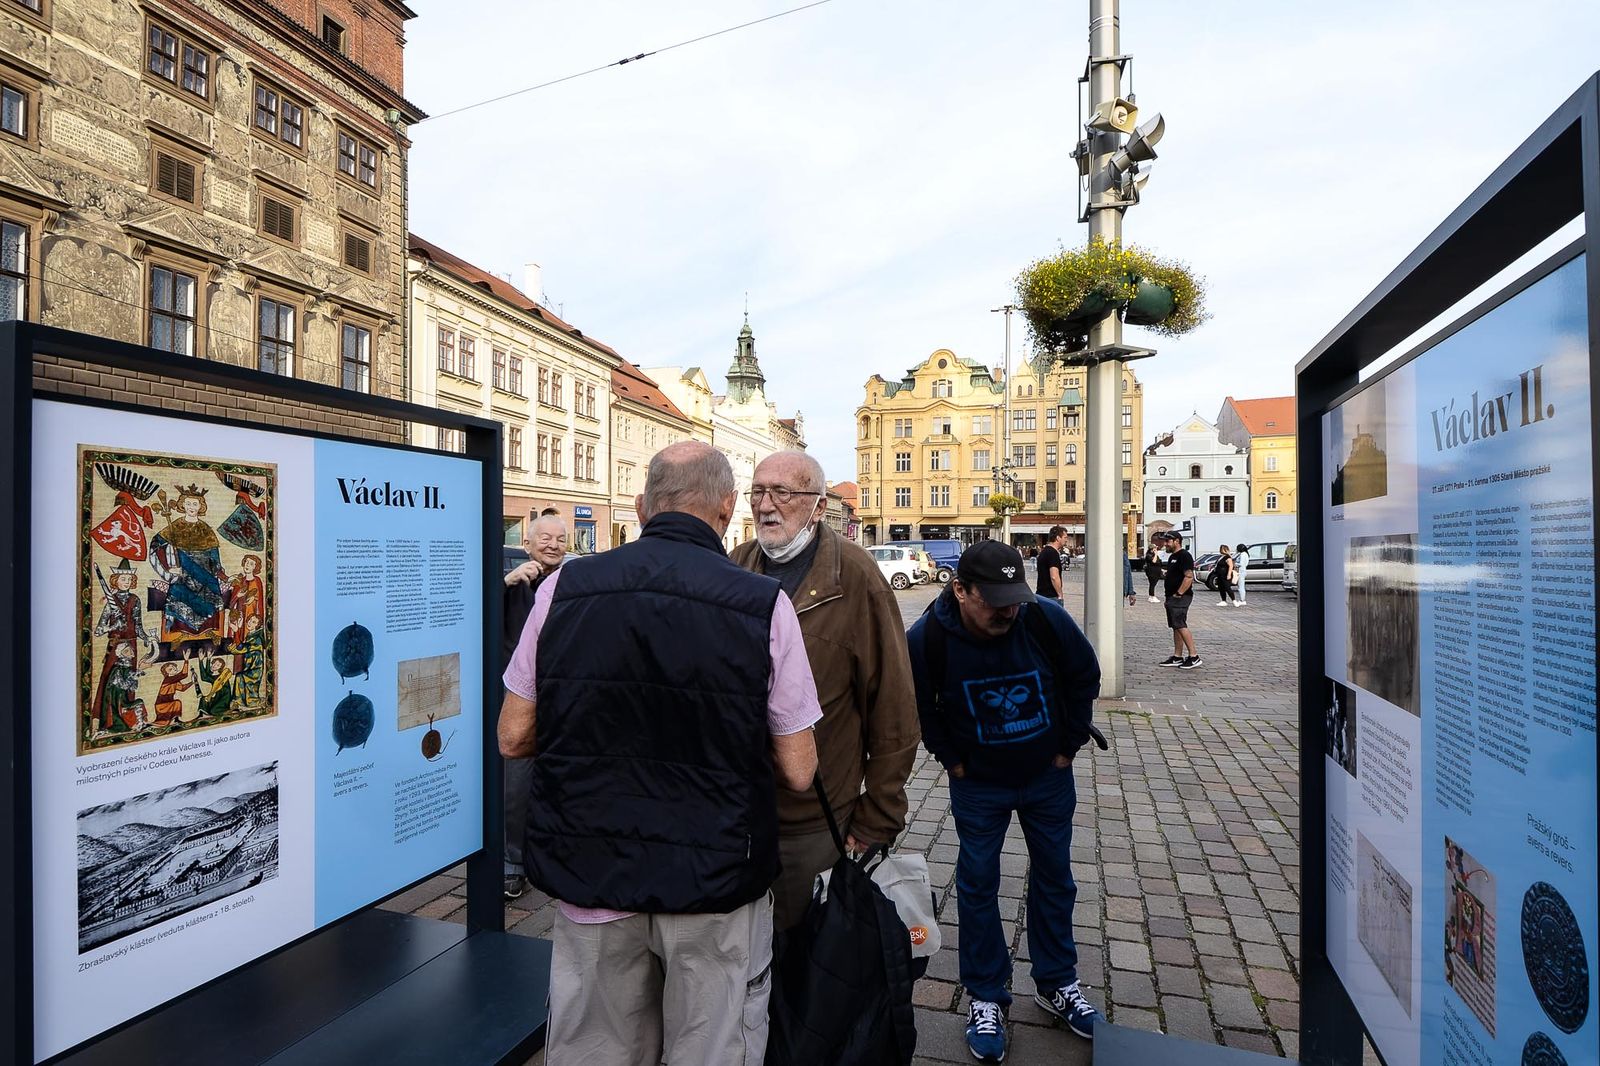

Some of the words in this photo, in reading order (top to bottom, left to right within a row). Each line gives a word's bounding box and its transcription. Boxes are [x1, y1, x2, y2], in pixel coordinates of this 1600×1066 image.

[1430, 391, 1514, 452] Václav
[1518, 364, 1555, 427] II.
[1489, 473, 1501, 484] 1305
[1501, 471, 1513, 482] Staré
[1514, 468, 1529, 479] Město
[1530, 463, 1551, 478] pražské
[336, 477, 419, 508] Václav
[424, 485, 446, 510] II.
[76, 757, 123, 774] Vyobrazení
[124, 748, 157, 764] českého
[159, 746, 177, 757] krále
[179, 741, 205, 754] Václava
[213, 736, 228, 746] jako
[229, 731, 250, 742] autora
[76, 769, 121, 785] milostných
[123, 765, 141, 776] písní
[149, 756, 178, 770] Codexu
[179, 751, 212, 763] Manesse.
[333, 779, 353, 788] Václava
[1528, 812, 1552, 841] Pražský
[1552, 832, 1569, 850] groš
[1528, 835, 1544, 854] avers
[1550, 850, 1574, 874] revers.
[78, 946, 128, 973] Zbraslavský
[130, 935, 156, 953] klášter
[157, 920, 185, 941] (veduta
[186, 911, 213, 930] kláštera
[220, 905, 232, 915] 18.
[910, 929, 926, 942] gsk
